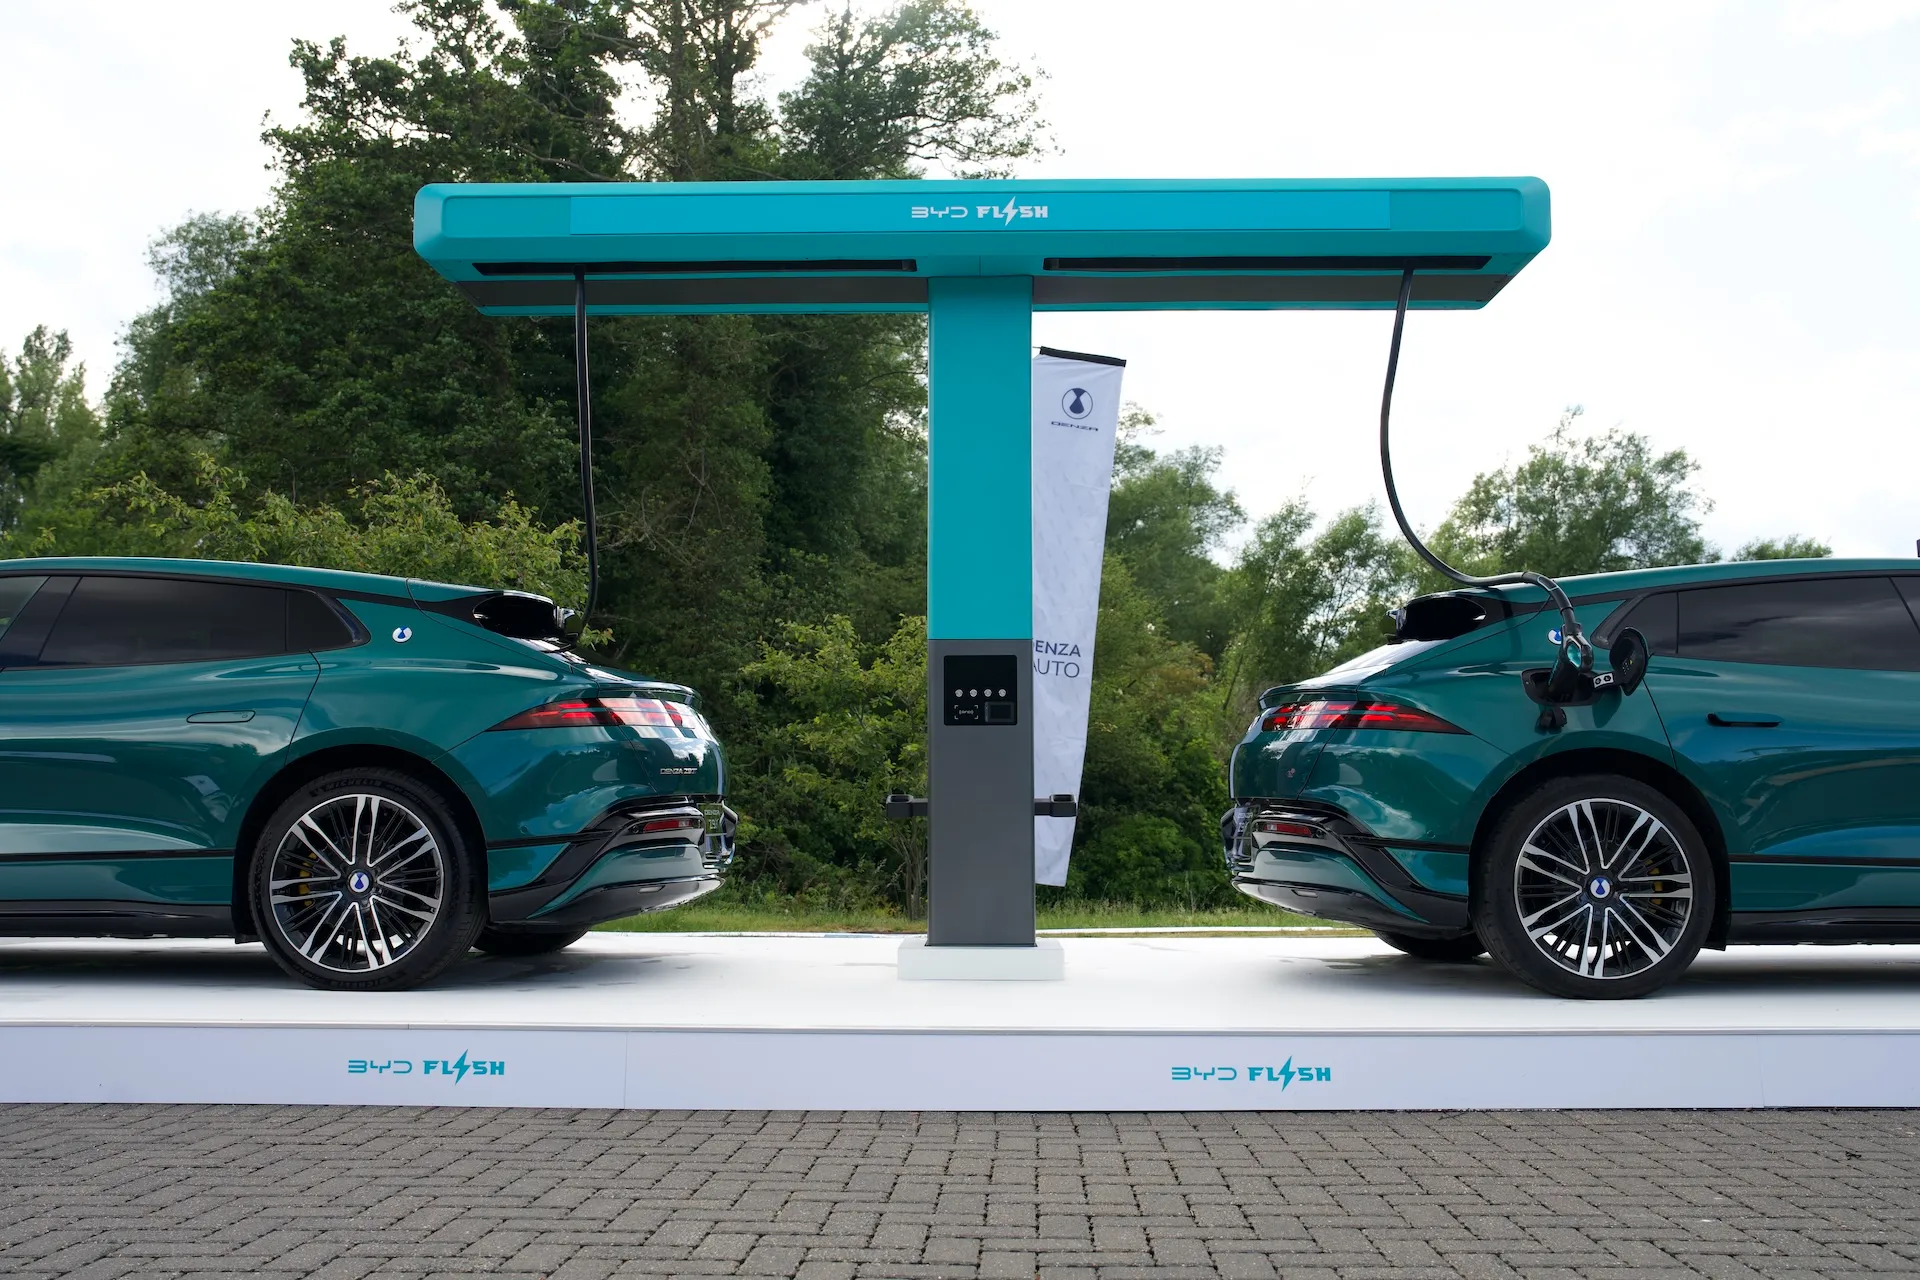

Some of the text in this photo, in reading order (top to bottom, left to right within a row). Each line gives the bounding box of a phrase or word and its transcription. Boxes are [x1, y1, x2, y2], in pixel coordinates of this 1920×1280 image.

[911, 206, 968, 219] BYD
[1051, 421, 1099, 432] DENZA
[1032, 639, 1081, 658] ENZA
[348, 1060, 412, 1074] BYD
[1171, 1066, 1237, 1081] BYD
